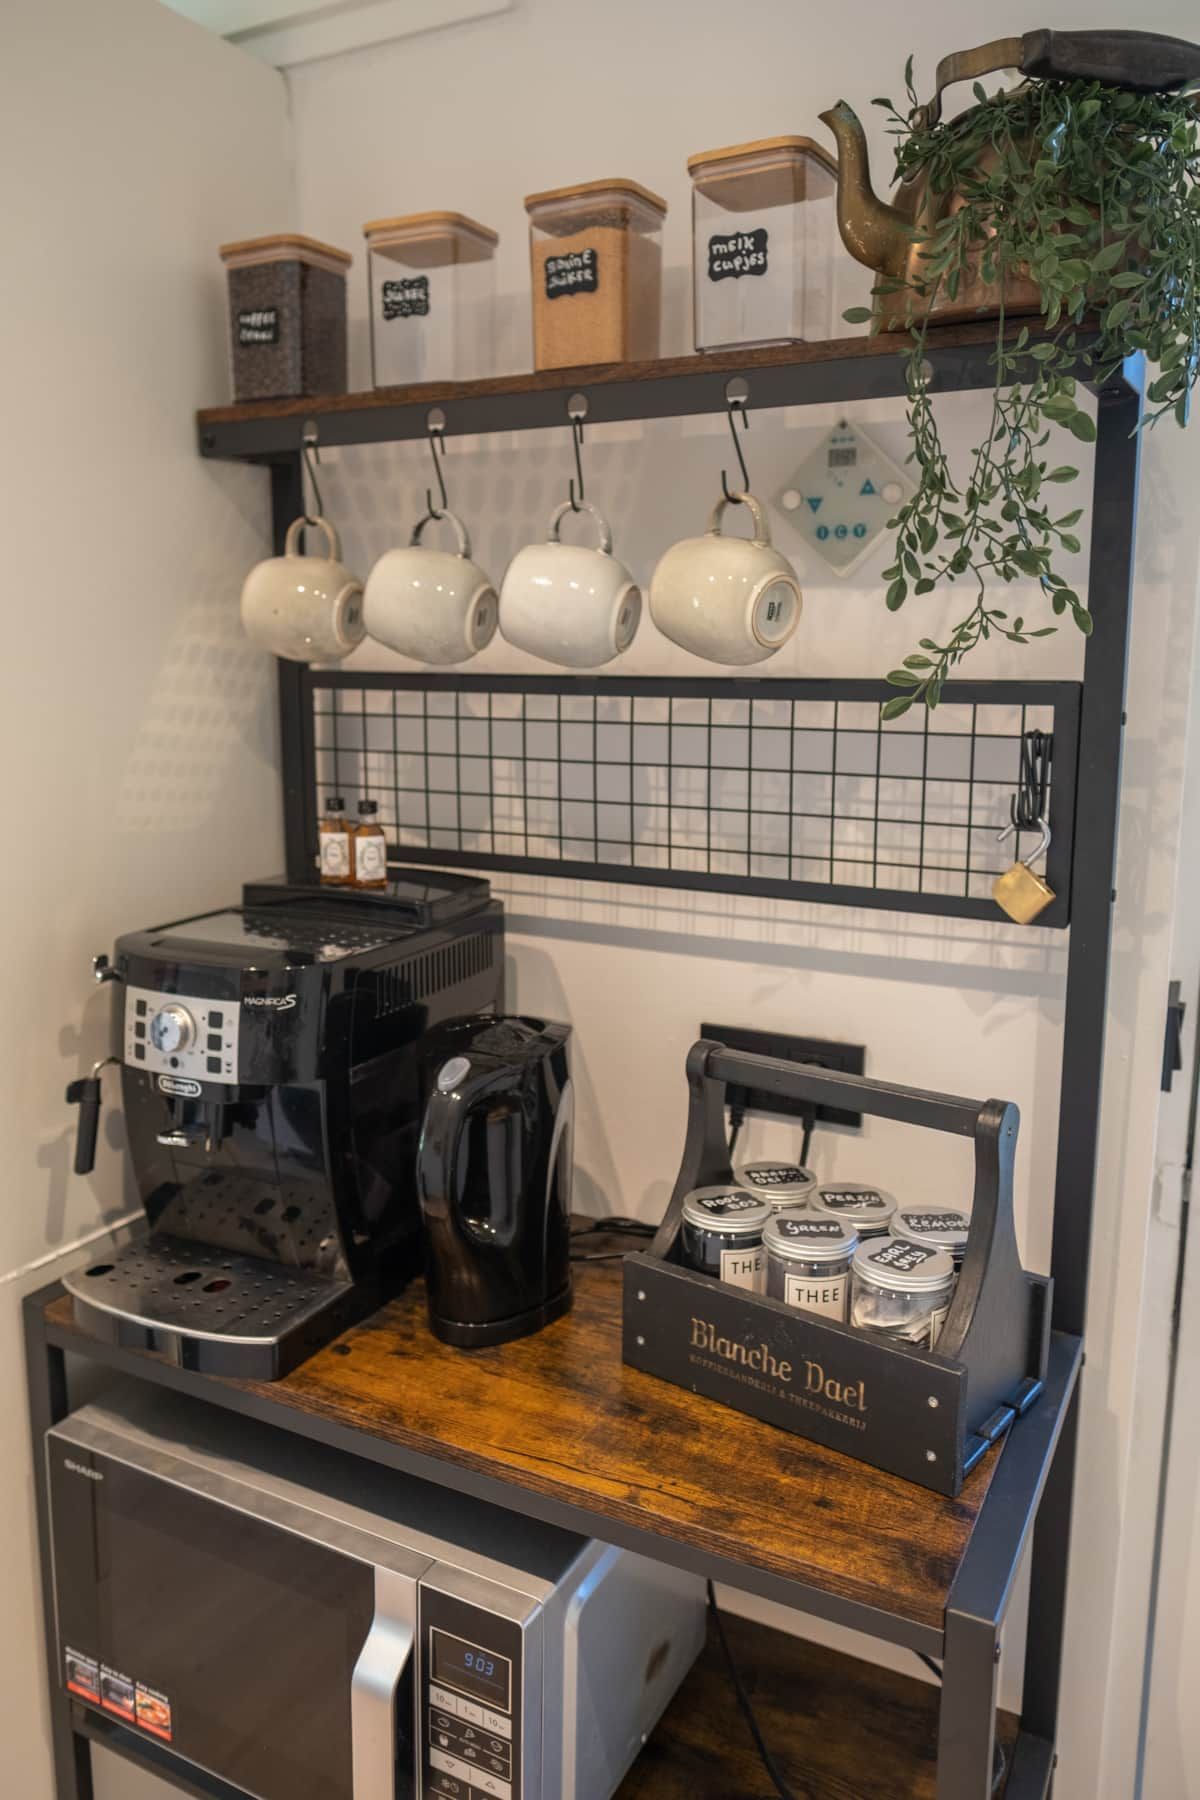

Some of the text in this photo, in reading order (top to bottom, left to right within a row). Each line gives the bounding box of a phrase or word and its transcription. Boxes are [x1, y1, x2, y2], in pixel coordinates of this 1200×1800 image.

[731, 1259, 762, 1275] THE
[795, 1287, 840, 1304] THEE
[690, 1317, 868, 1412] Blanche Dael
